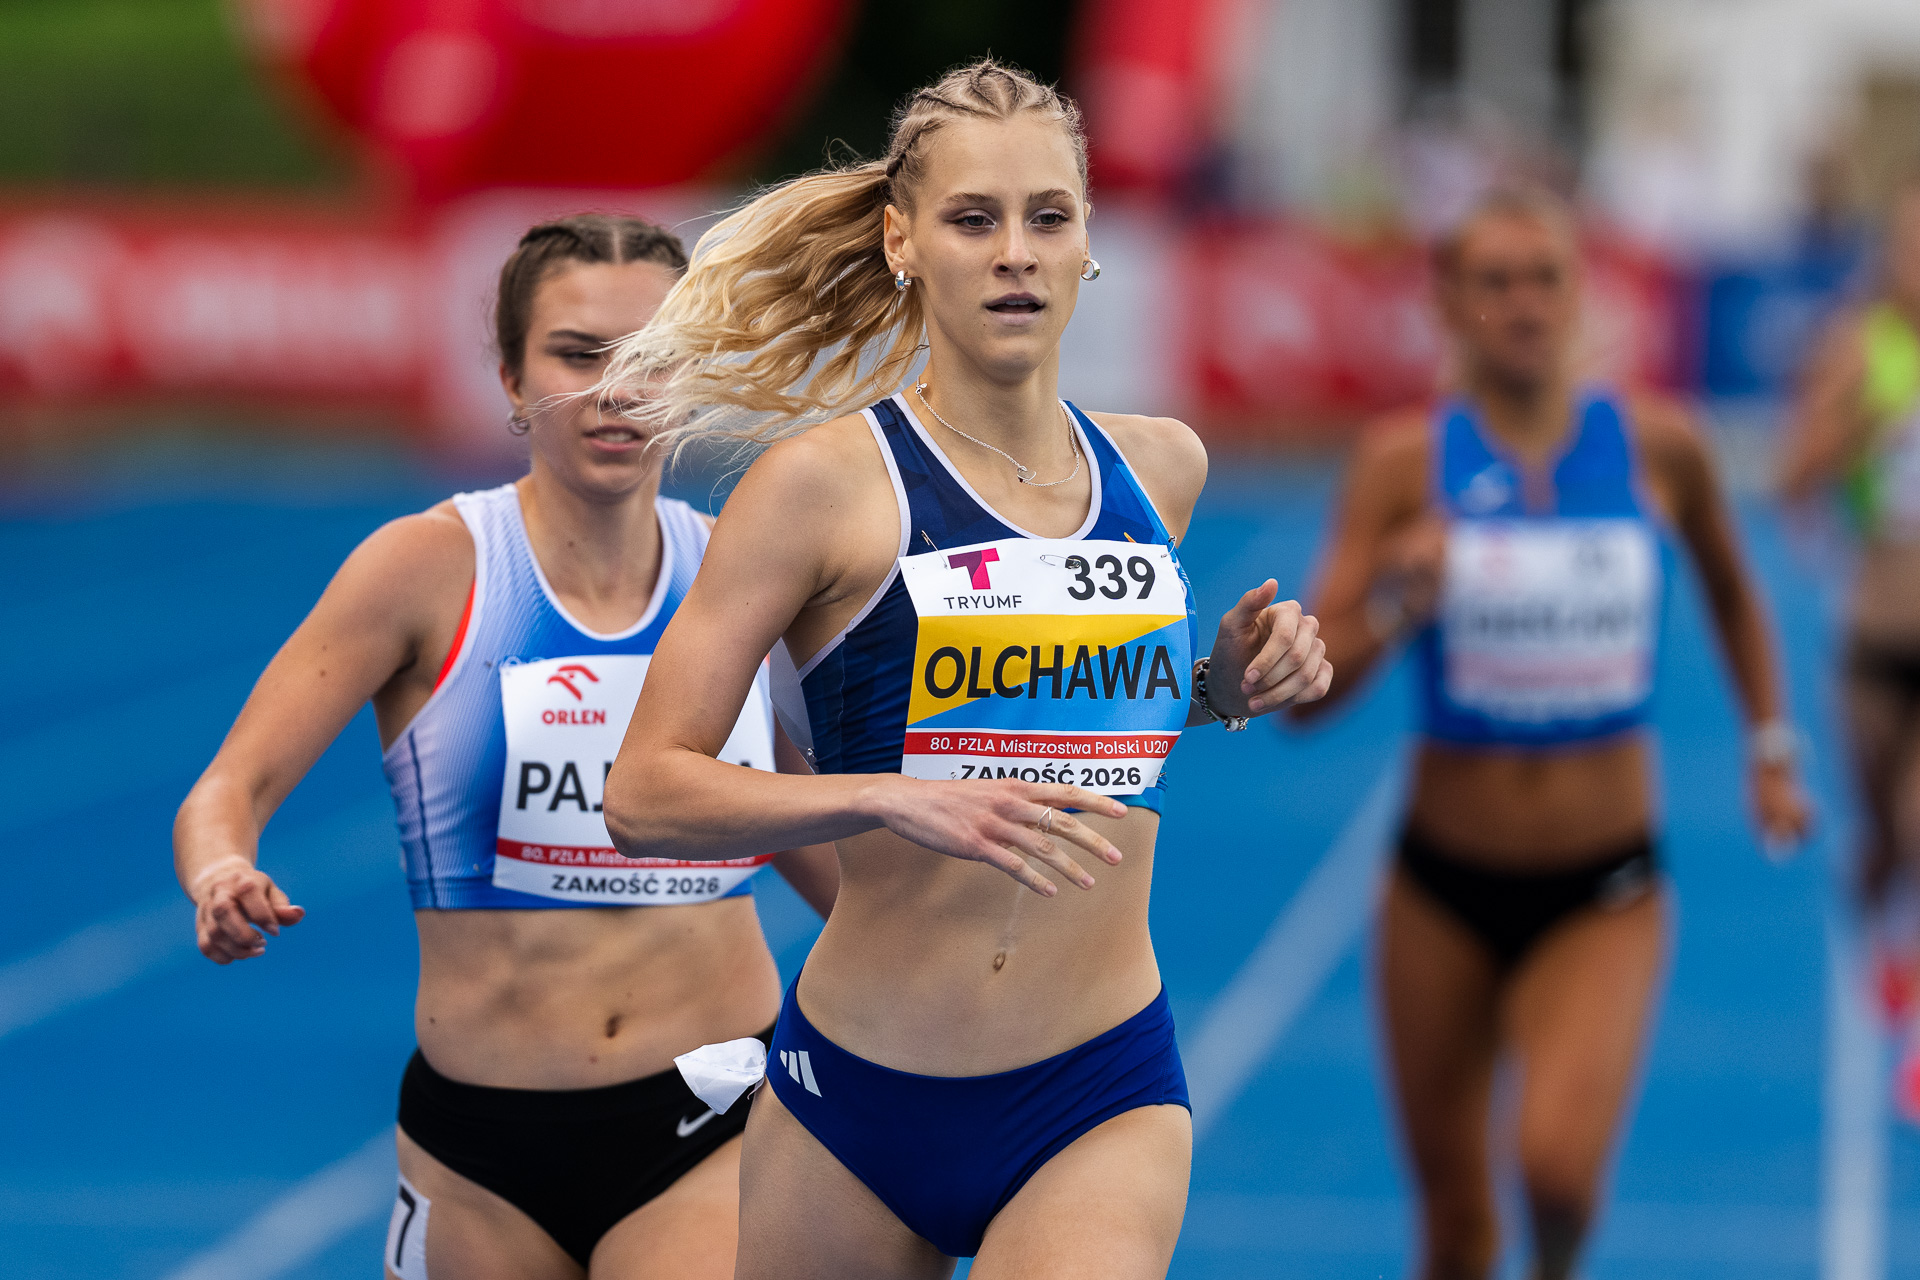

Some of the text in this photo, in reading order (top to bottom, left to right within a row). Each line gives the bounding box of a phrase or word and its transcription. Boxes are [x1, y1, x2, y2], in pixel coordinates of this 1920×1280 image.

[1066, 553, 1156, 601] 339
[944, 594, 1022, 610] TRYUMF
[924, 644, 1181, 700] OLCHAWA
[541, 709, 606, 725] ORLEN
[930, 737, 1169, 755] 80. PZLA Mistrzostwa Polski U20
[961, 762, 1142, 787] ZAMOŚĆ 2026
[548, 848, 587, 865] PZLA
[551, 872, 720, 895] ZAMOŚĆ 2026
[395, 1184, 417, 1268] 7
